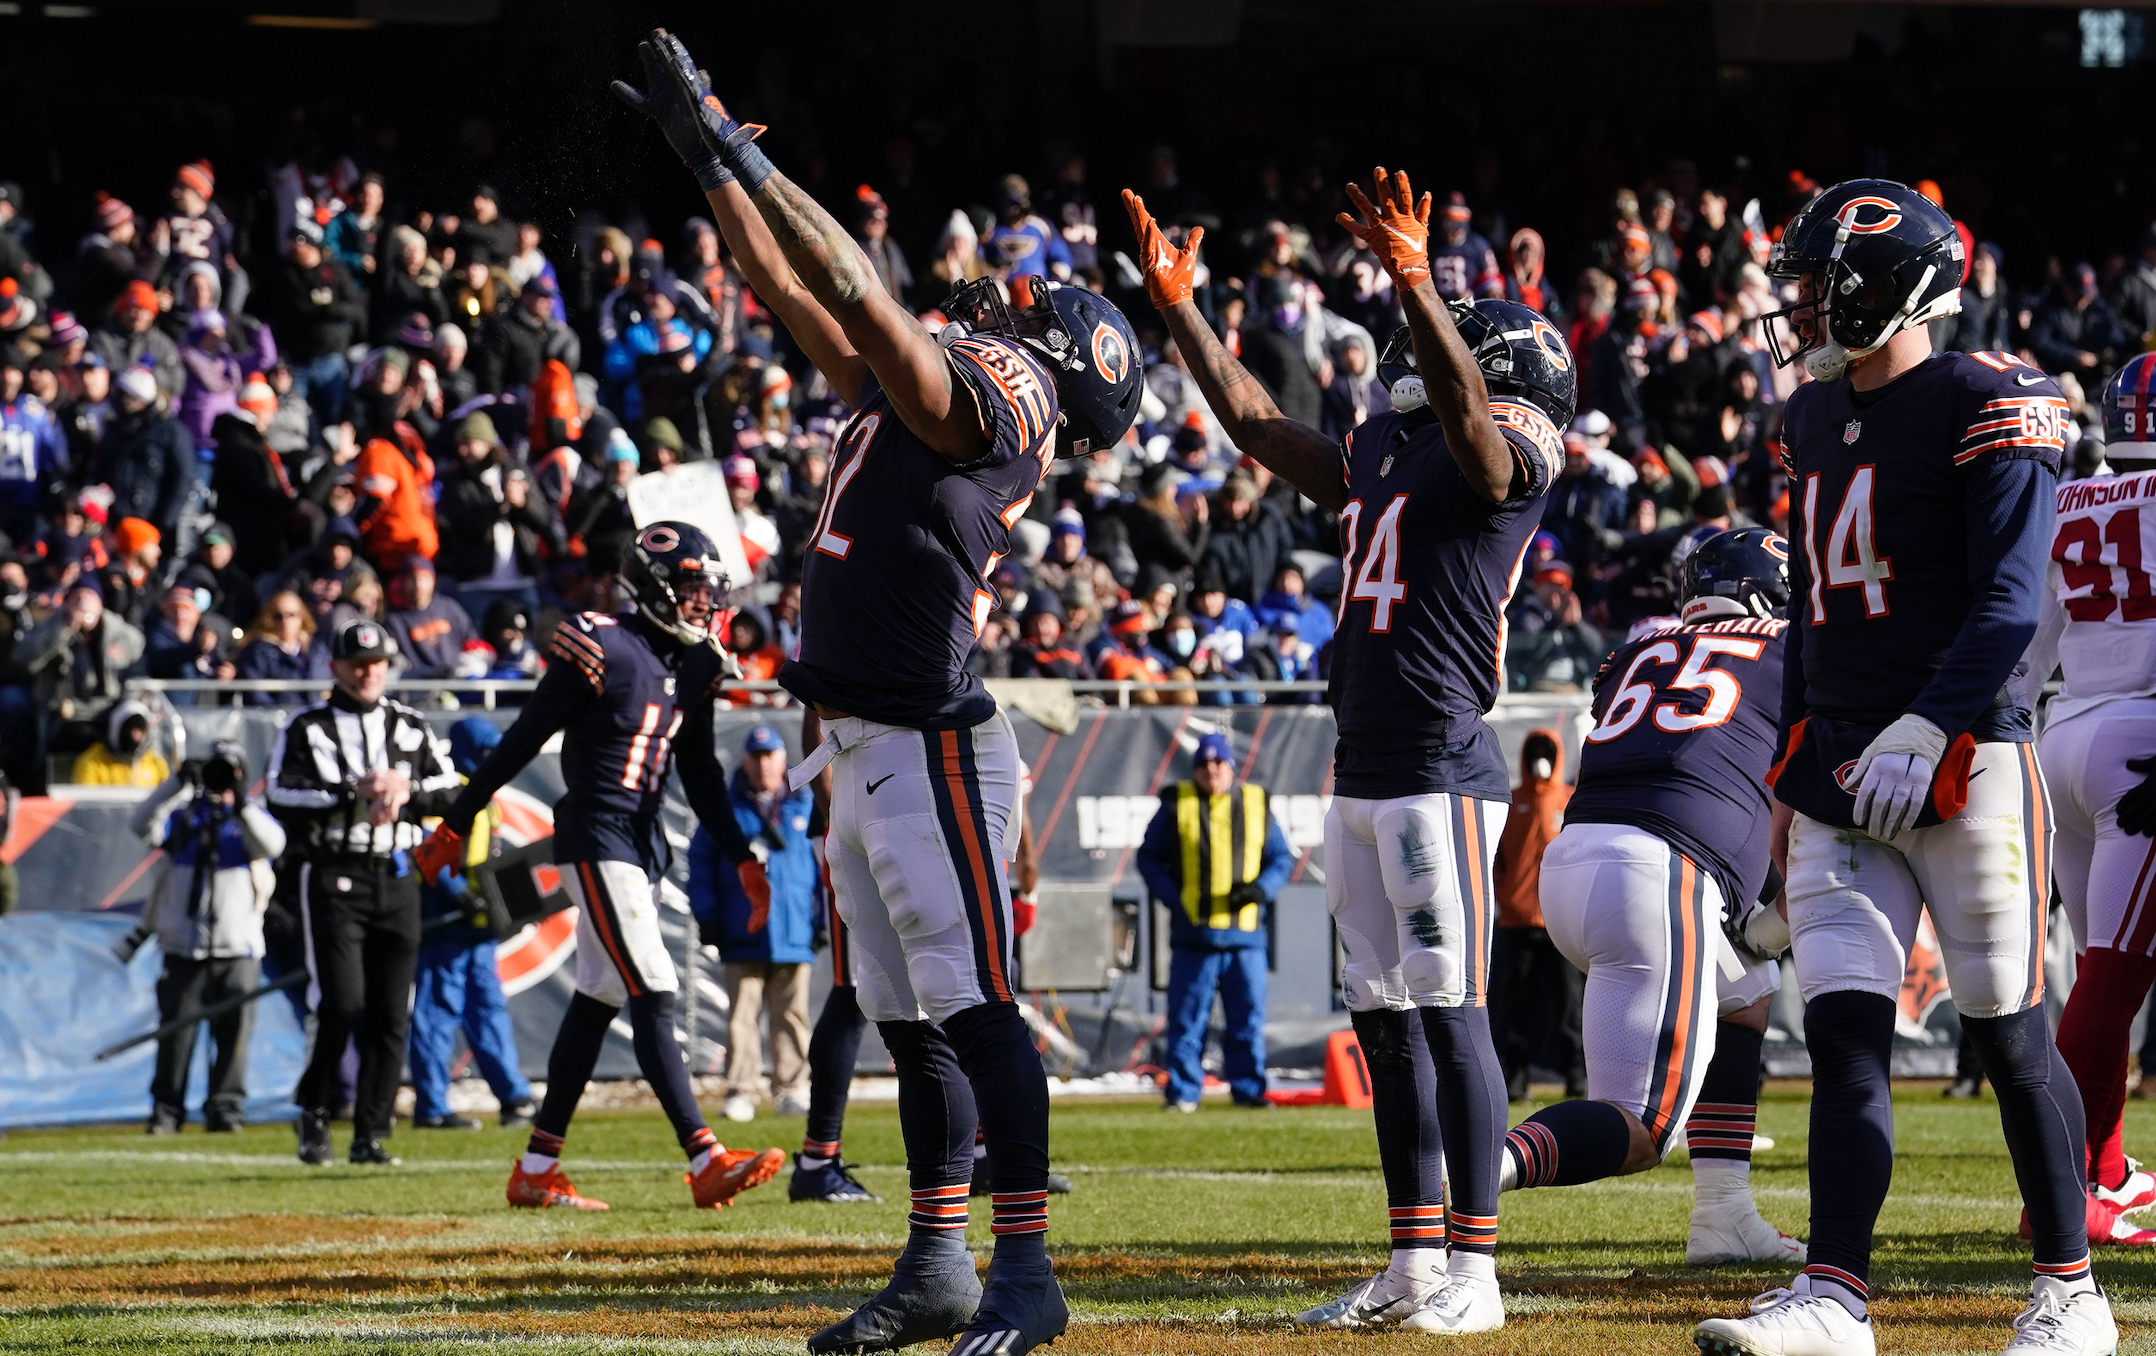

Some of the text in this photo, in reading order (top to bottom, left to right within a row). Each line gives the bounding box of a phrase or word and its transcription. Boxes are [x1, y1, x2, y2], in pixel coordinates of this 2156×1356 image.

[977, 345, 1036, 399] GSH
[1508, 407, 1553, 450] GSH
[2019, 405, 2061, 440] GSH
[2124, 411, 2155, 434] 91
[805, 409, 882, 562] 2
[2057, 476, 2141, 514] OHNSON
[1802, 463, 1895, 626] 14
[2051, 507, 2156, 622] 91
[1683, 602, 1708, 621] ARS
[1586, 634, 1766, 744] 65
[622, 703, 684, 793] 11
[1077, 795, 1162, 848] 197
